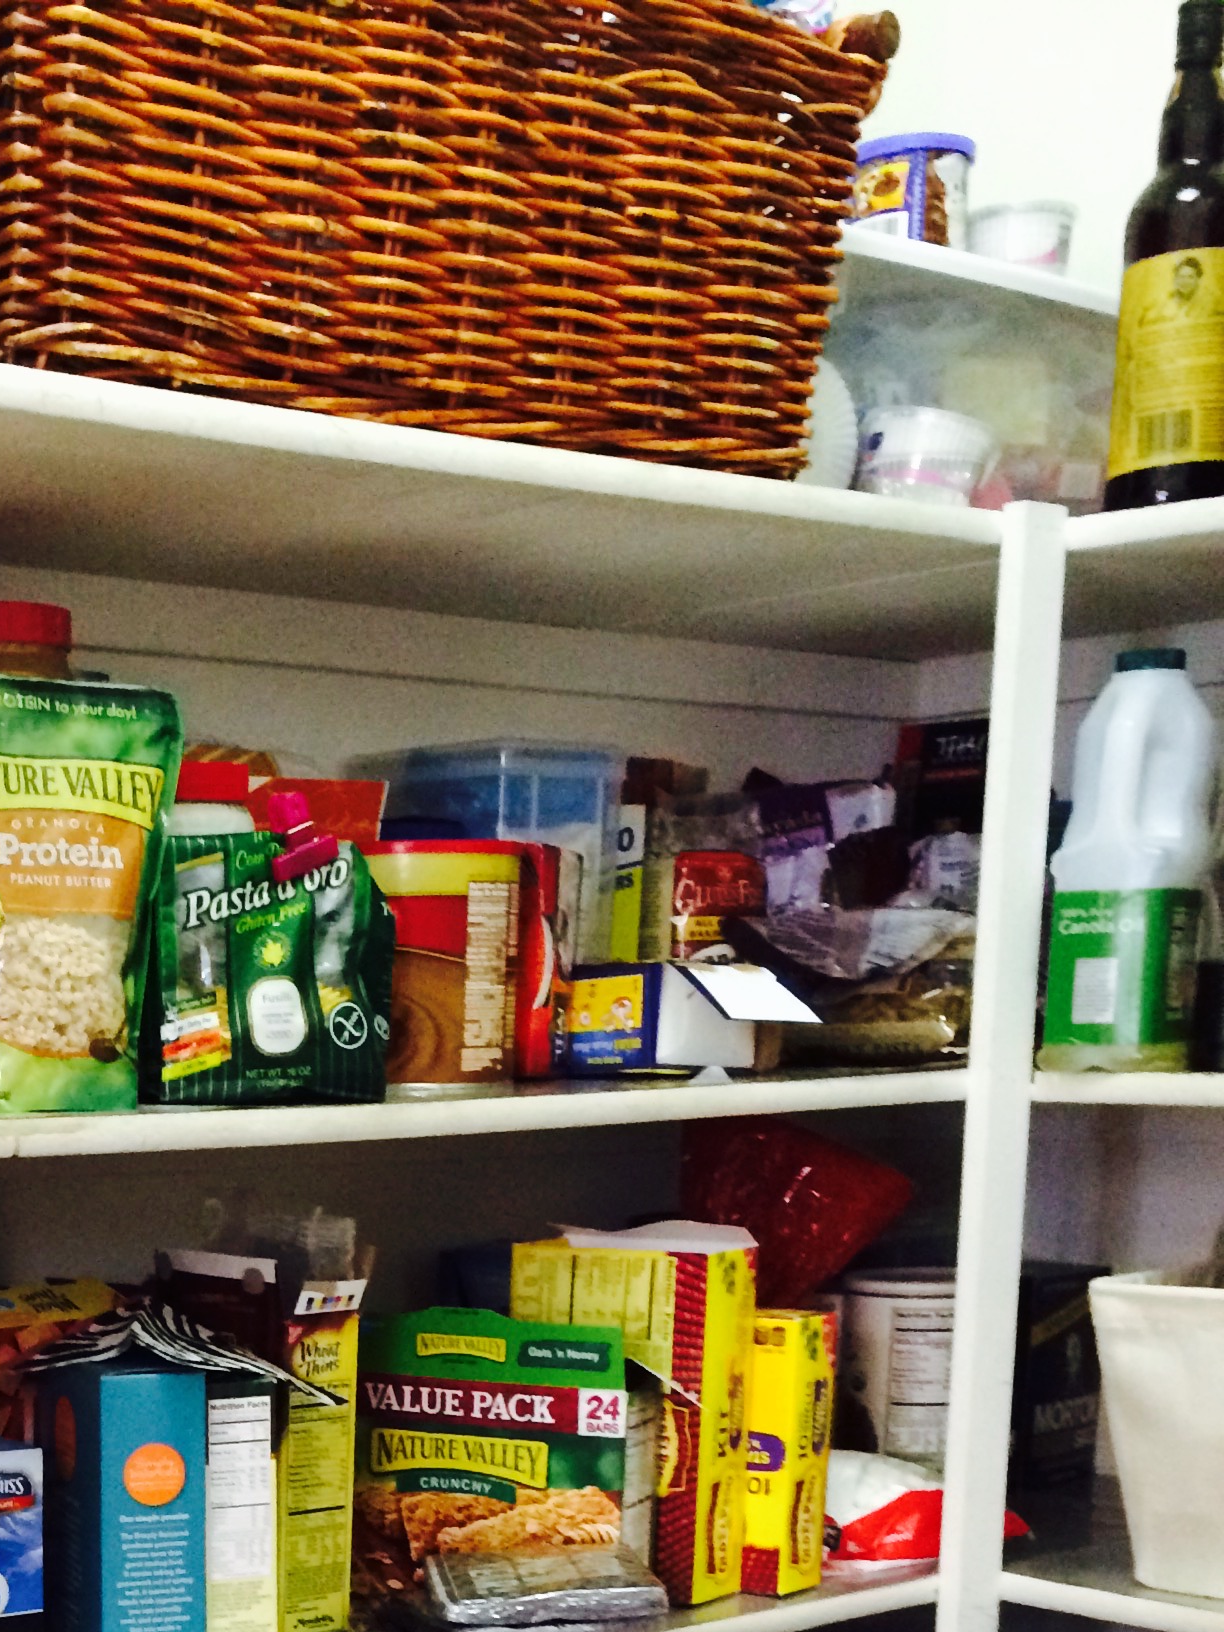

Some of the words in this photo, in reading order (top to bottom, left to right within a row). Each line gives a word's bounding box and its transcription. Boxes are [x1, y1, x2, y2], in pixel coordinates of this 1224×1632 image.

[55, 700, 70, 714] to
[72, 702, 103, 717] your
[106, 703, 138, 721] day!
[60, 765, 161, 824] VALLEY
[11, 817, 105, 834] GRANOLA
[10, 872, 61, 887] PEANUT
[65, 873, 112, 890] BUTTER
[185, 879, 272, 930] Pasta
[235, 911, 275, 935] Gluten
[279, 901, 308, 920] Free
[299, 1336, 341, 1362] Wheat
[419, 1335, 463, 1350] NATURE
[463, 1336, 503, 1356] VALLEY
[527, 1346, 552, 1359] Oats
[566, 1347, 600, 1363] Honey
[364, 1381, 464, 1417] VALUE
[470, 1389, 556, 1425] PACK
[586, 1394, 621, 1421] 24
[1033, 1394, 1098, 1434] MORTO
[586, 1421, 620, 1434] BARS
[377, 1431, 459, 1467] NATURE
[462, 1439, 543, 1480] VALLEY
[419, 1477, 493, 1494] CRUNCHY
